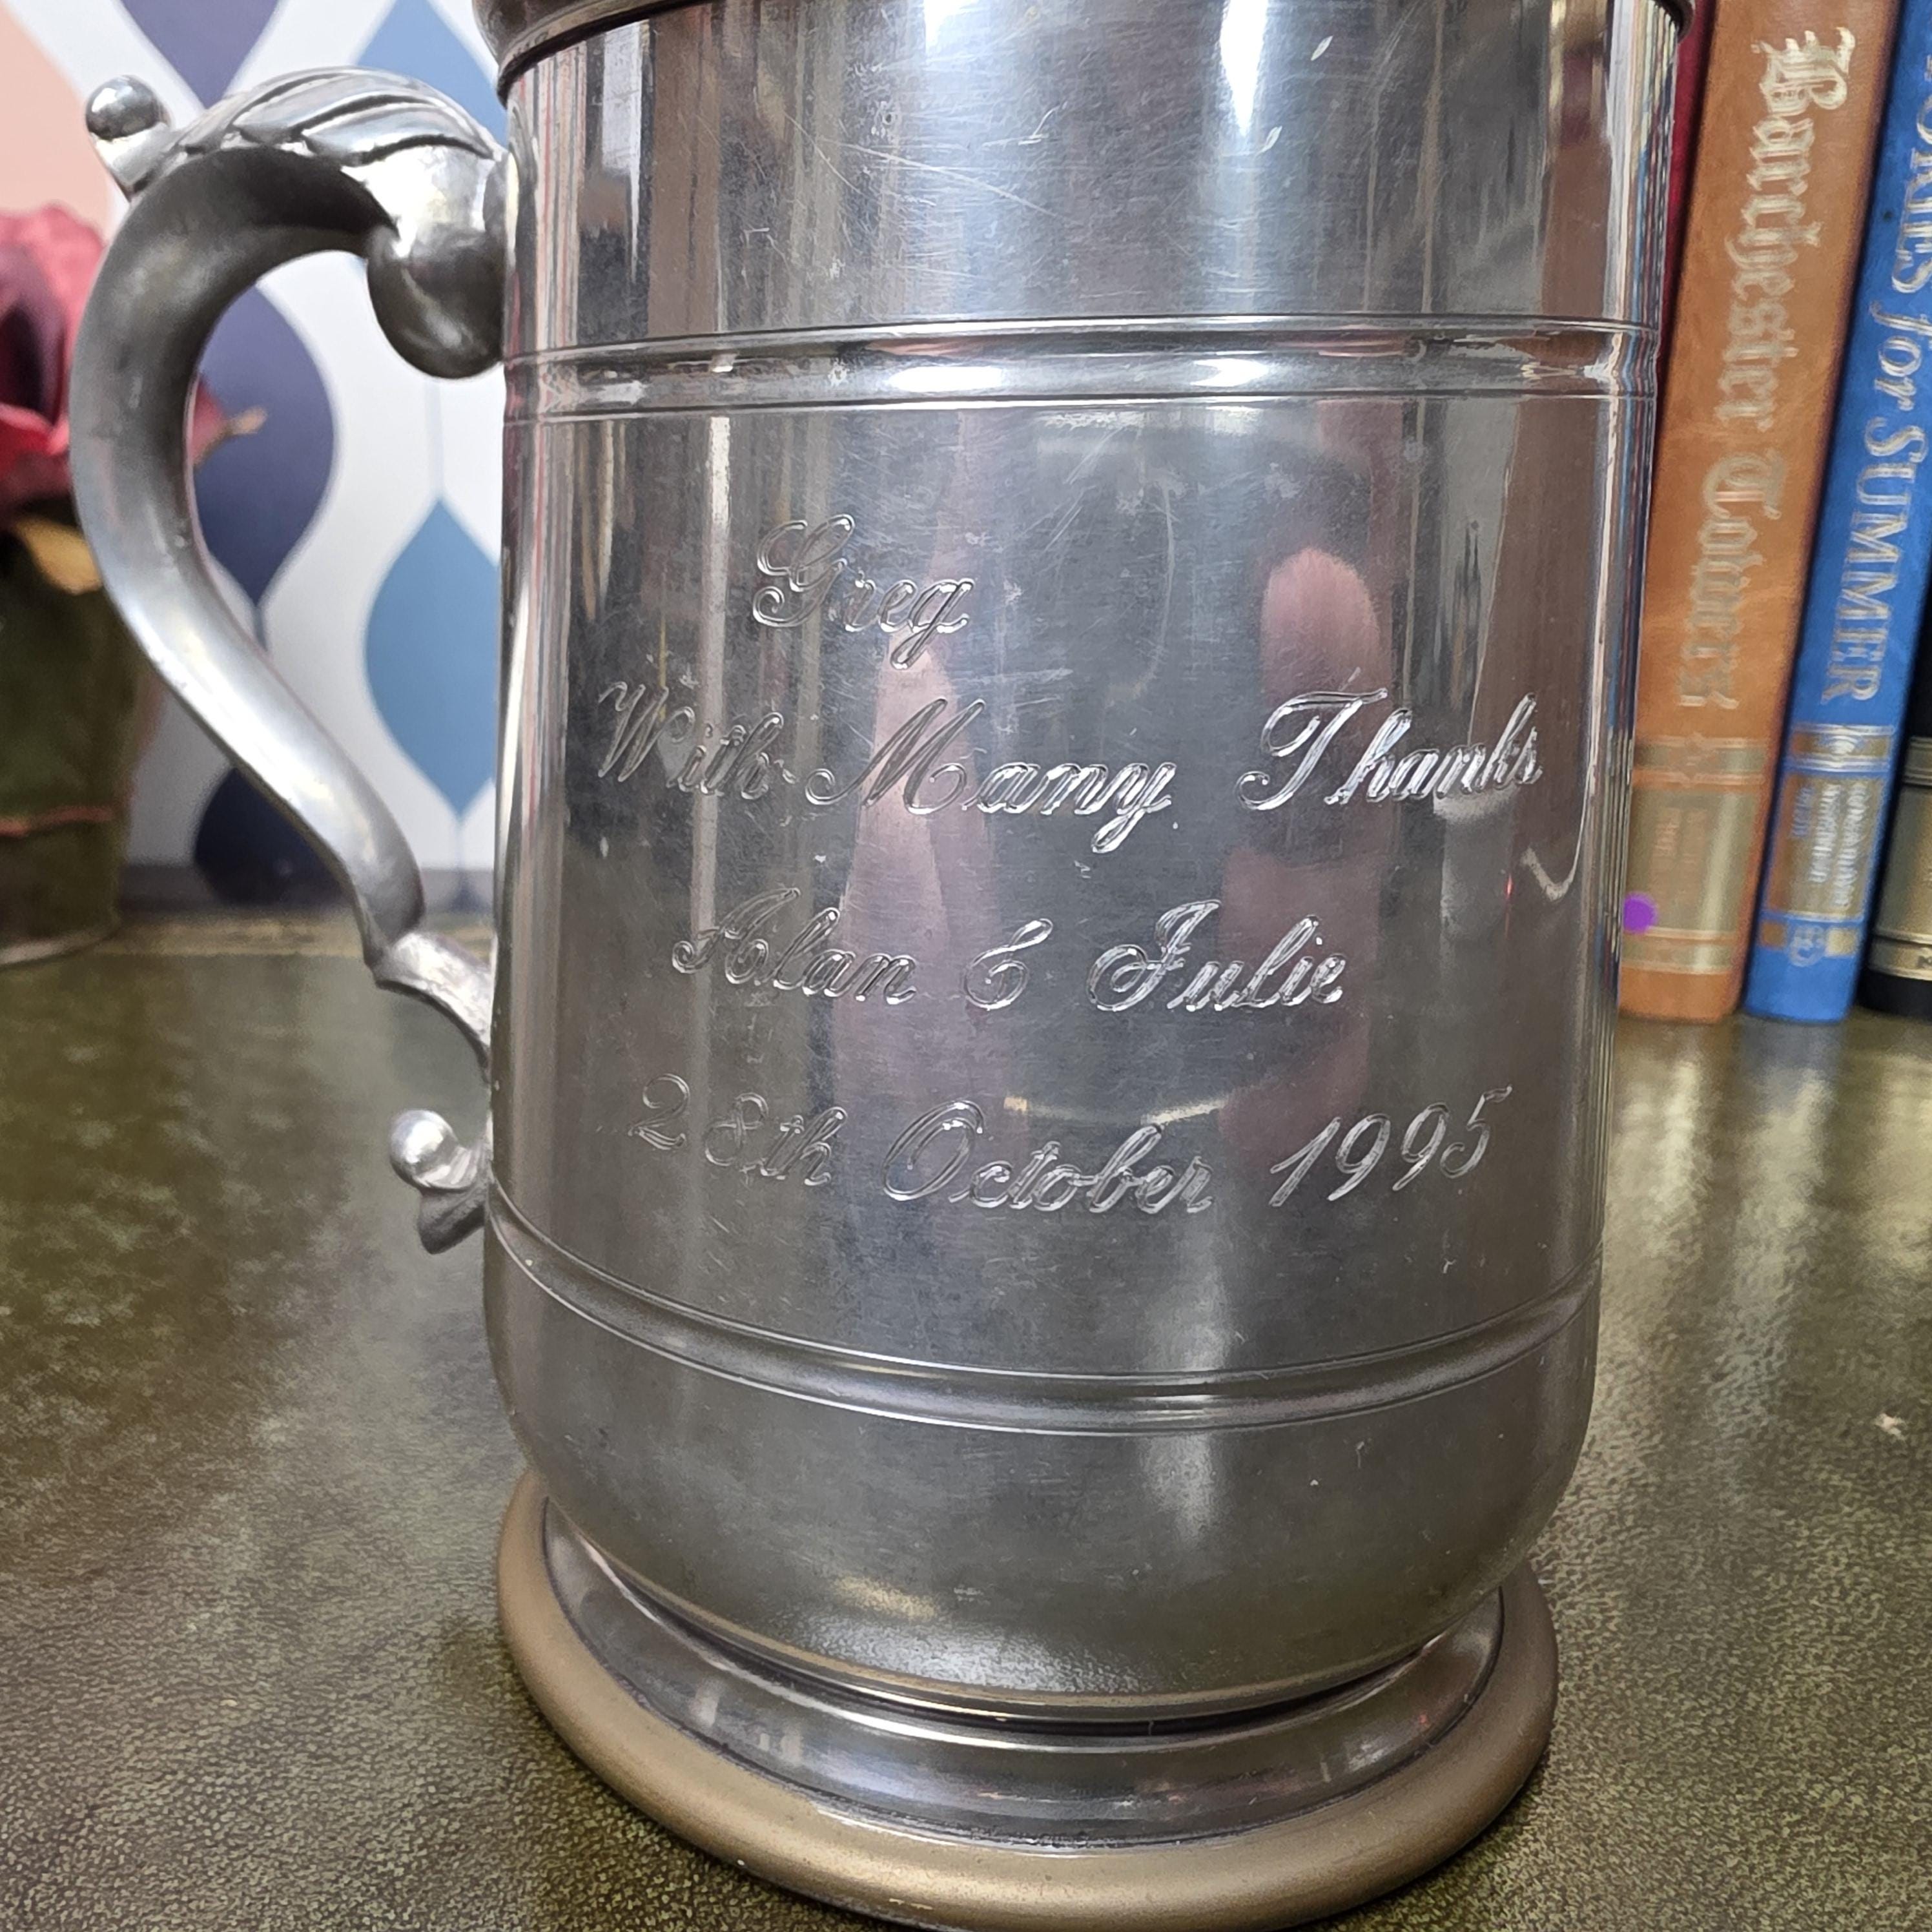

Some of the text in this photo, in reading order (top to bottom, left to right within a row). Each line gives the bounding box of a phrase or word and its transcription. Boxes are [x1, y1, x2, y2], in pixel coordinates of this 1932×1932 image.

[1678, 26, 1856, 709] Barchester Towers
[752, 514, 975, 670] Greg
[1820, 416, 1929, 704] SUMMER
[597, 681, 1543, 854] With Many Thanks
[672, 887, 917, 1005] Alan
[1085, 898, 1346, 1012] Julie
[882, 1099, 1213, 1214] October
[1269, 1084, 1513, 1208] 1995
